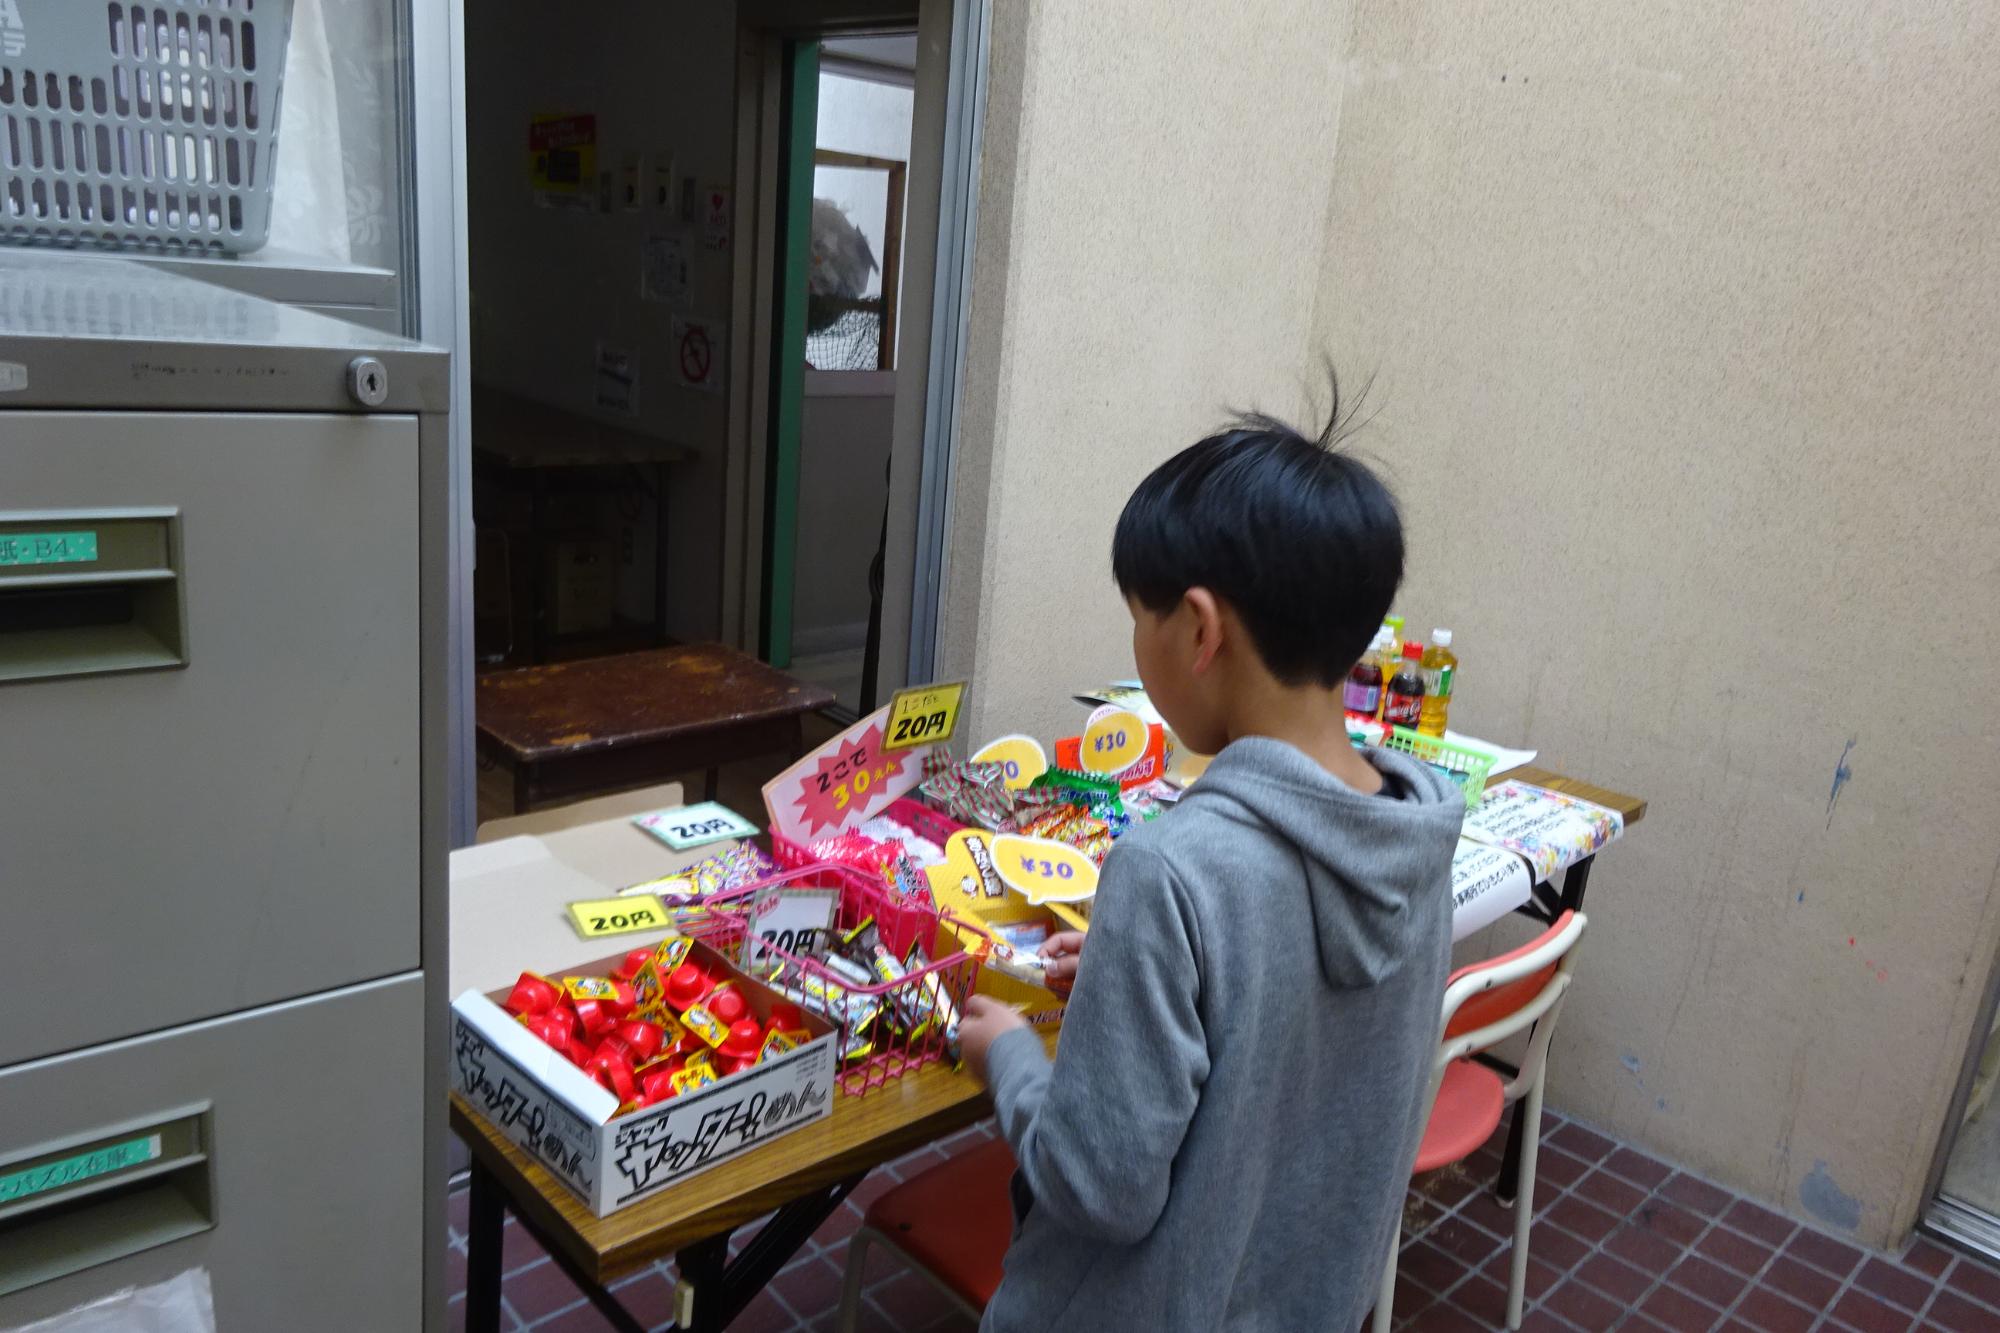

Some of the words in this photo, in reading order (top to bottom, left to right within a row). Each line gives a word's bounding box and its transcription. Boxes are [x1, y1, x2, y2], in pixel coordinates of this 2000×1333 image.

[893, 711, 947, 743] 20円
[1094, 730, 1126, 752] ¥30
[817, 746, 867, 793] 2こで
[669, 817, 736, 840] 20円
[1021, 855, 1074, 880] ¥30
[589, 909, 657, 931] 20円
